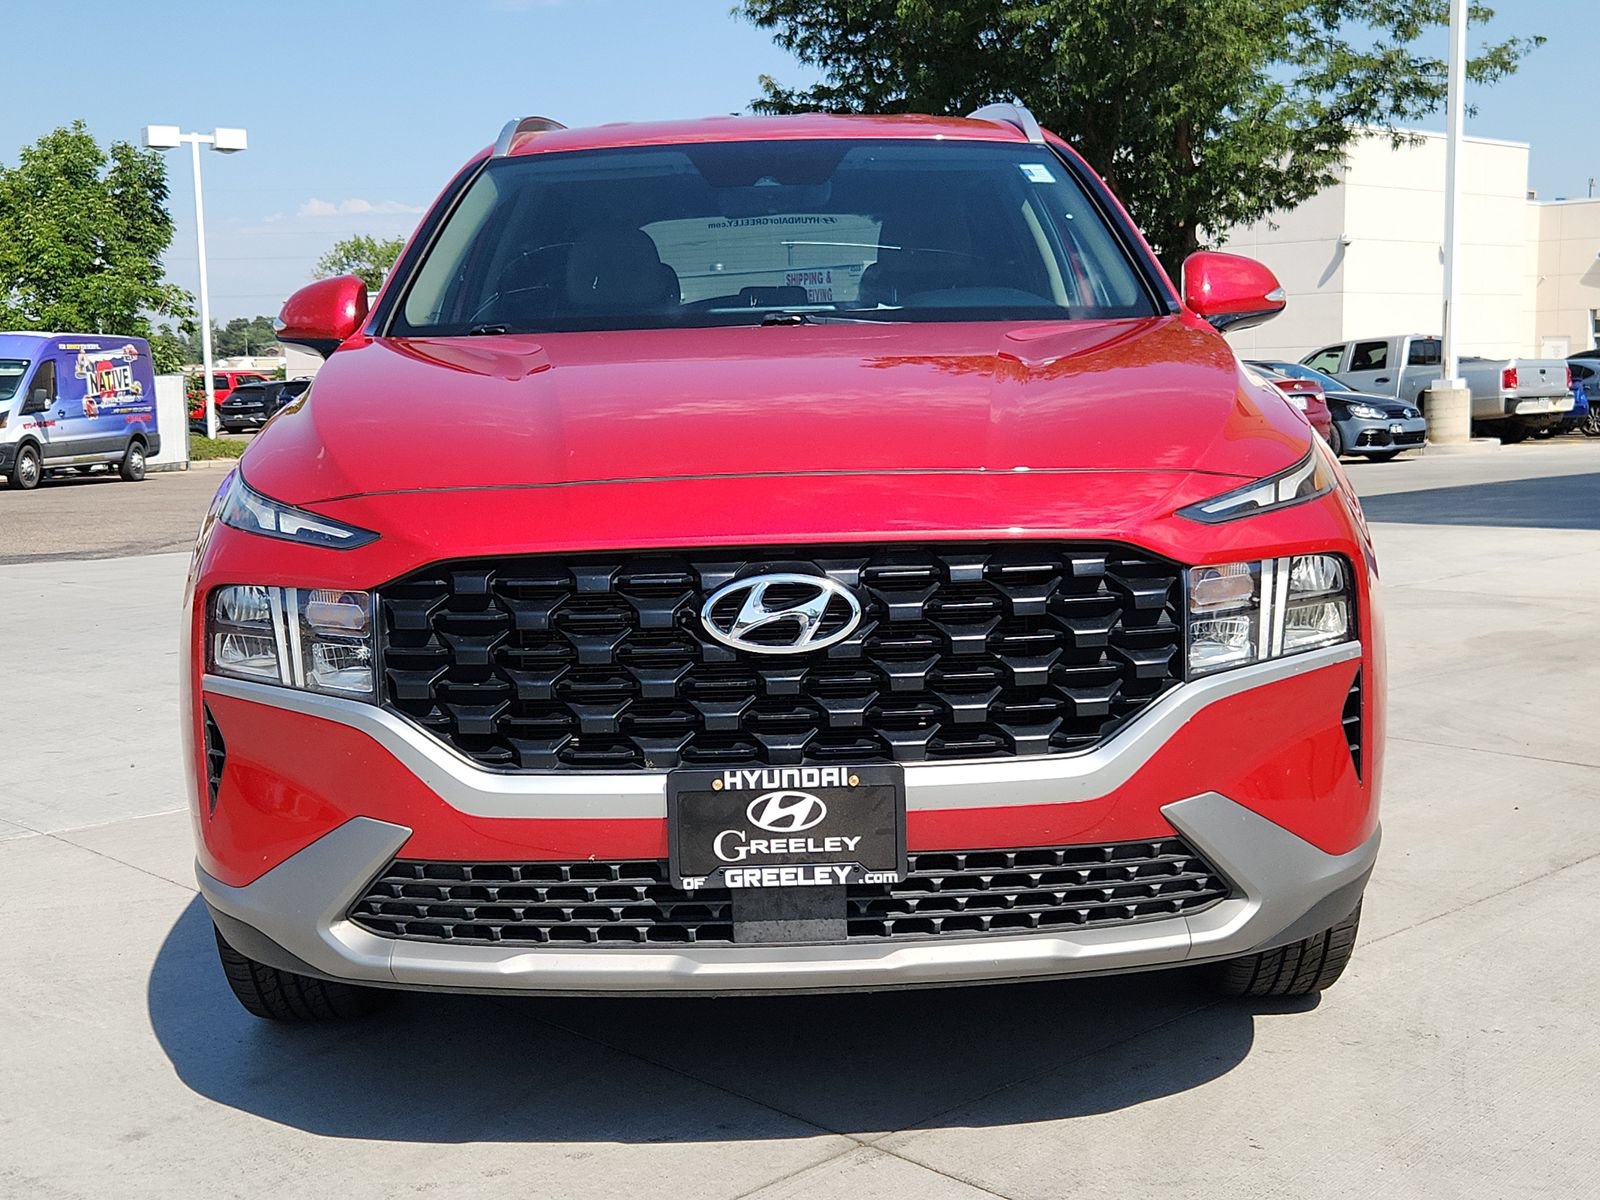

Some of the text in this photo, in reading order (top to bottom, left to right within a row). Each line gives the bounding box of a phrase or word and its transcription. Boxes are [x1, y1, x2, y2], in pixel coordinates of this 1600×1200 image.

[785, 270, 832, 286] SHIPPING &
[808, 287, 833, 302] EIVING
[89, 368, 130, 394] NATIVE
[723, 767, 849, 790] HYUNDAI
[713, 829, 862, 862] GREELEY
[724, 866, 851, 888] GREELEY
[857, 873, 899, 884] .com
